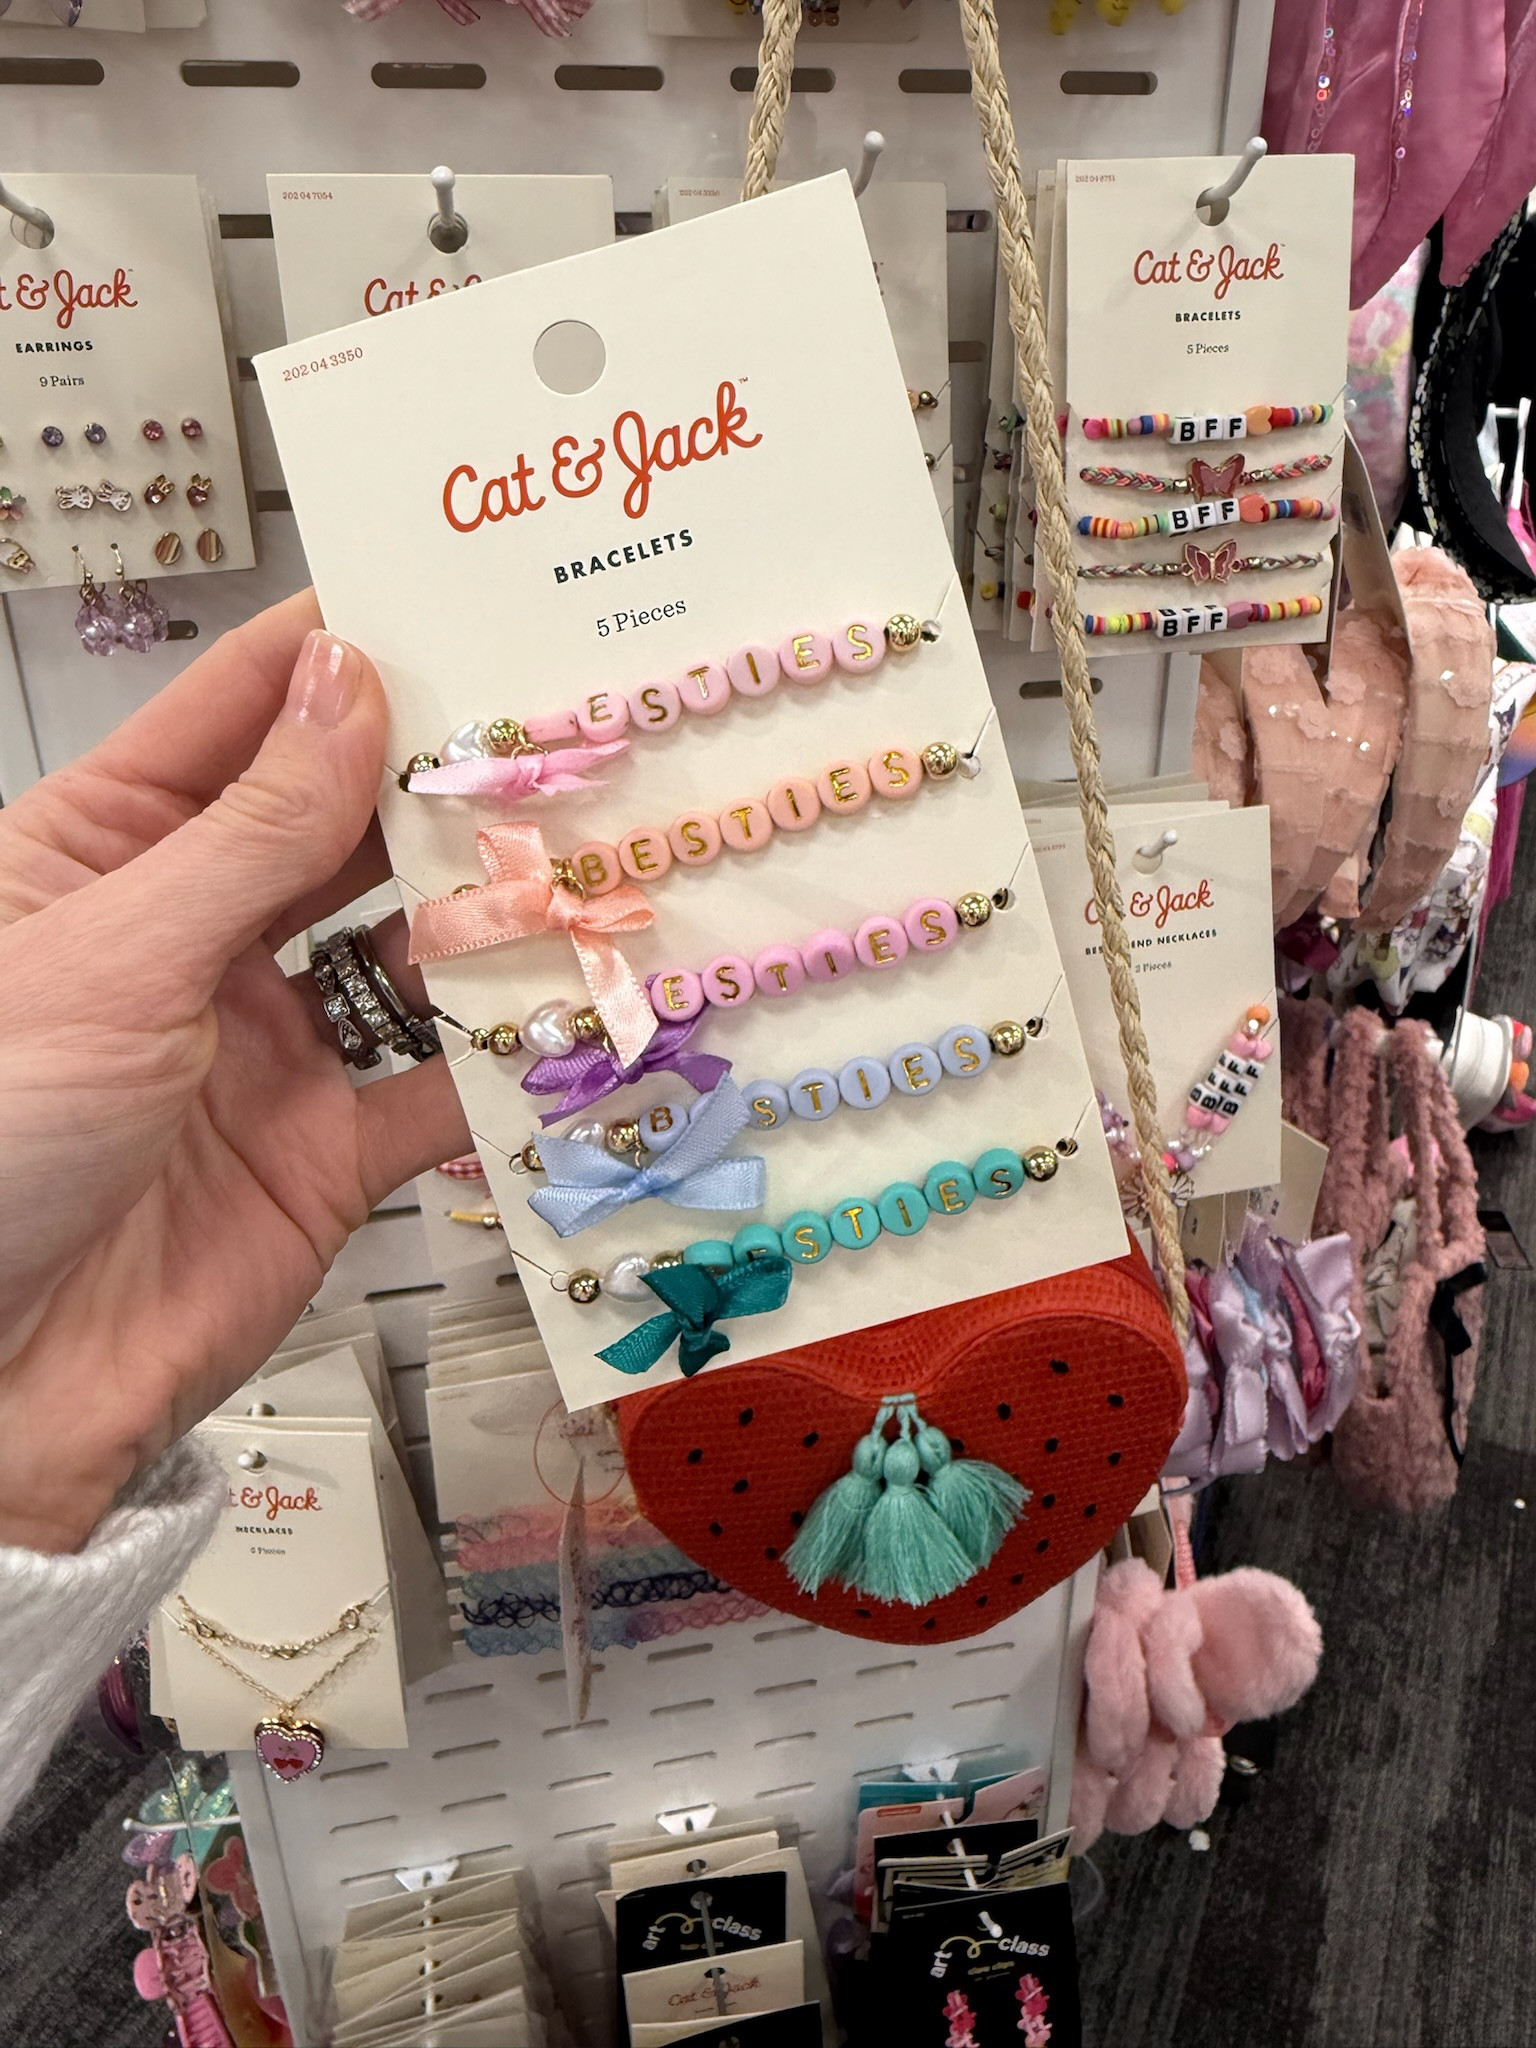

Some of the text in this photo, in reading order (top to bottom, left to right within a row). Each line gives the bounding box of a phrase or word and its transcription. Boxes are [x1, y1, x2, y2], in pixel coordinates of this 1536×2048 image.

[1133, 243, 1284, 300] Cat & Jack
[16, 273, 50, 310] &
[53, 268, 138, 329] Jack
[364, 278, 419, 317] Cat
[1174, 310, 1242, 323] BRACELETS
[15, 341, 94, 354] EARRINGS
[1186, 343, 1230, 355] 5 Pieces
[39, 374, 85, 388] 9 Pairs
[1180, 417, 1243, 441] BFF
[442, 453, 546, 533] Cat
[551, 435, 606, 498] &
[612, 381, 763, 519] Jack
[1172, 501, 1234, 529] BFF
[553, 528, 694, 585] BRACELETS
[596, 599, 687, 638] 5 Pieces
[1163, 612, 1224, 637] BFF
[586, 624, 873, 723] ESTIES
[580, 751, 910, 887] BESTIES
[1129, 891, 1153, 917] &
[1154, 879, 1214, 928] Jack
[662, 909, 946, 1012] ESTIES
[1085, 929, 1217, 956] BES END NECKLACES
[649, 1036, 981, 1133] BSTIES
[746, 1168, 1013, 1263] STIES
[240, 1487, 263, 1509] &
[265, 1486, 322, 1521] Jack
[642, 1916, 762, 1950] art class
[930, 1950, 953, 1979] art
[998, 1935, 1050, 1957] class
